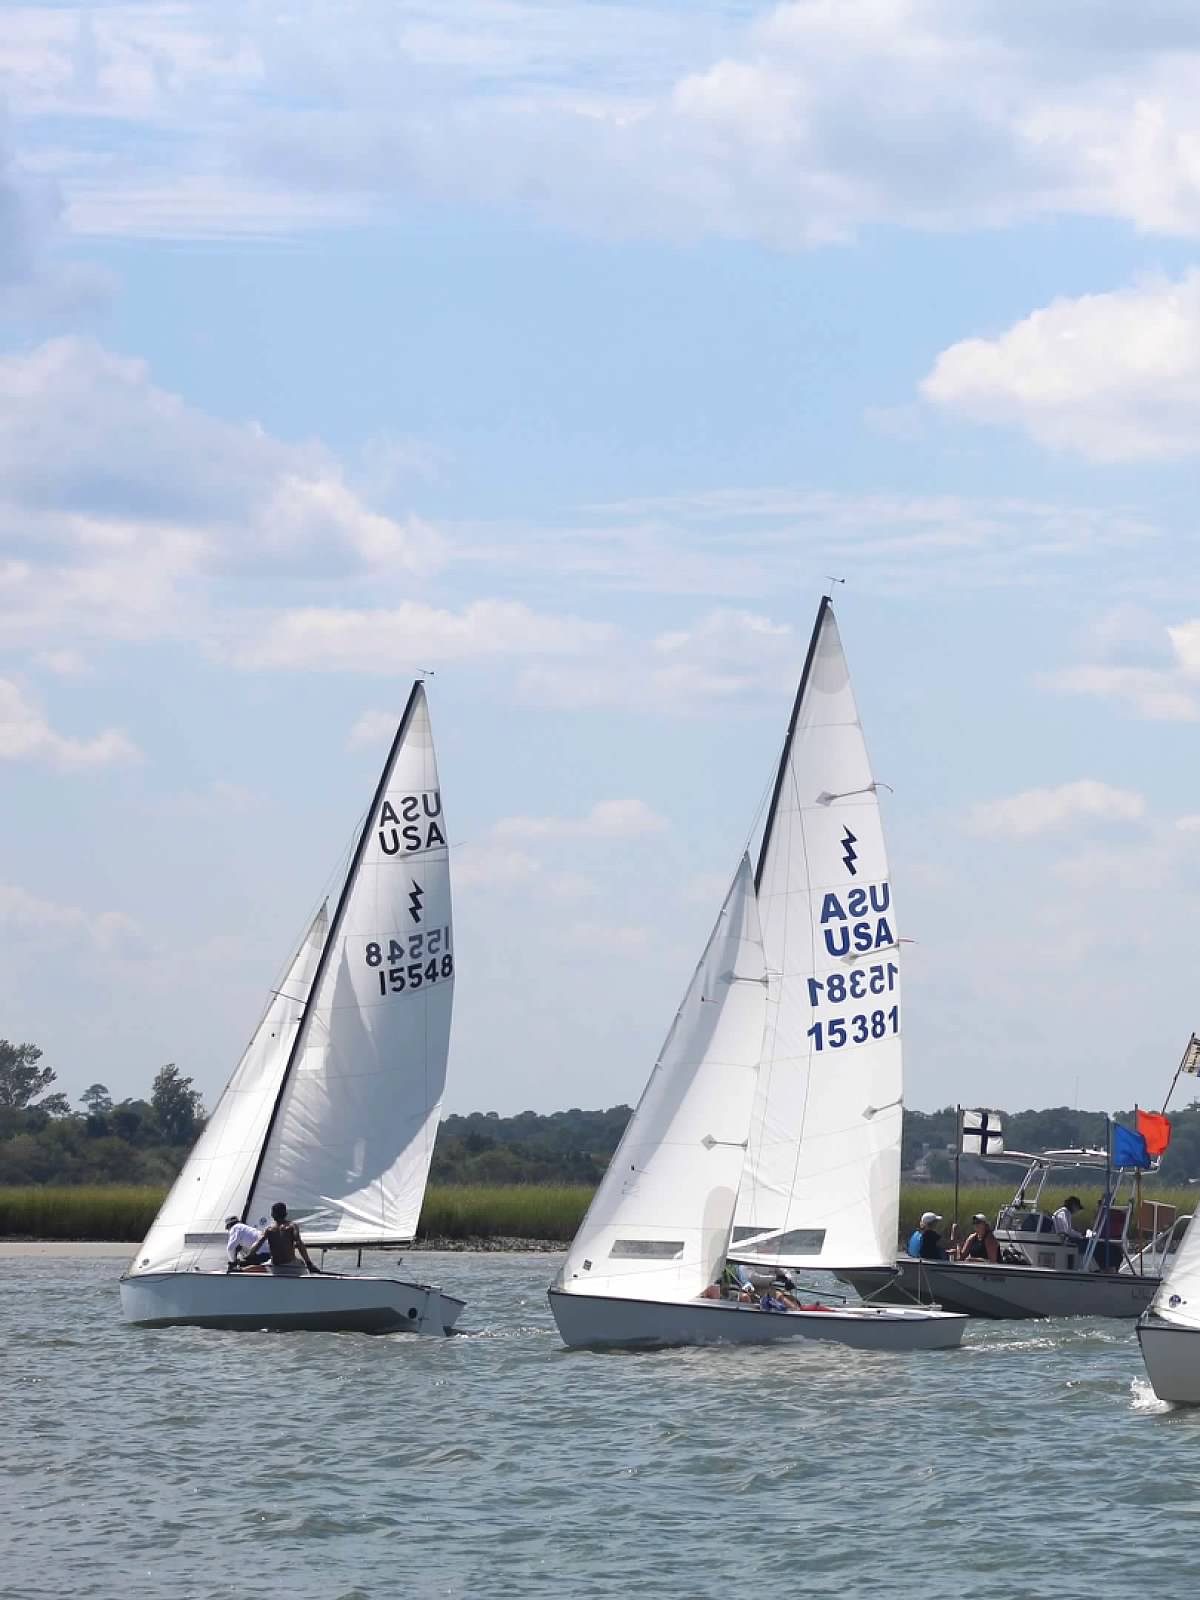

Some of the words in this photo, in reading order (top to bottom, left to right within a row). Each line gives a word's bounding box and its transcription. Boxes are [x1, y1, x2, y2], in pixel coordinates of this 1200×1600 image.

[379, 822, 445, 855] USA
[824, 917, 894, 957] USA
[379, 954, 453, 995] 15548
[807, 1005, 899, 1051] 15381
